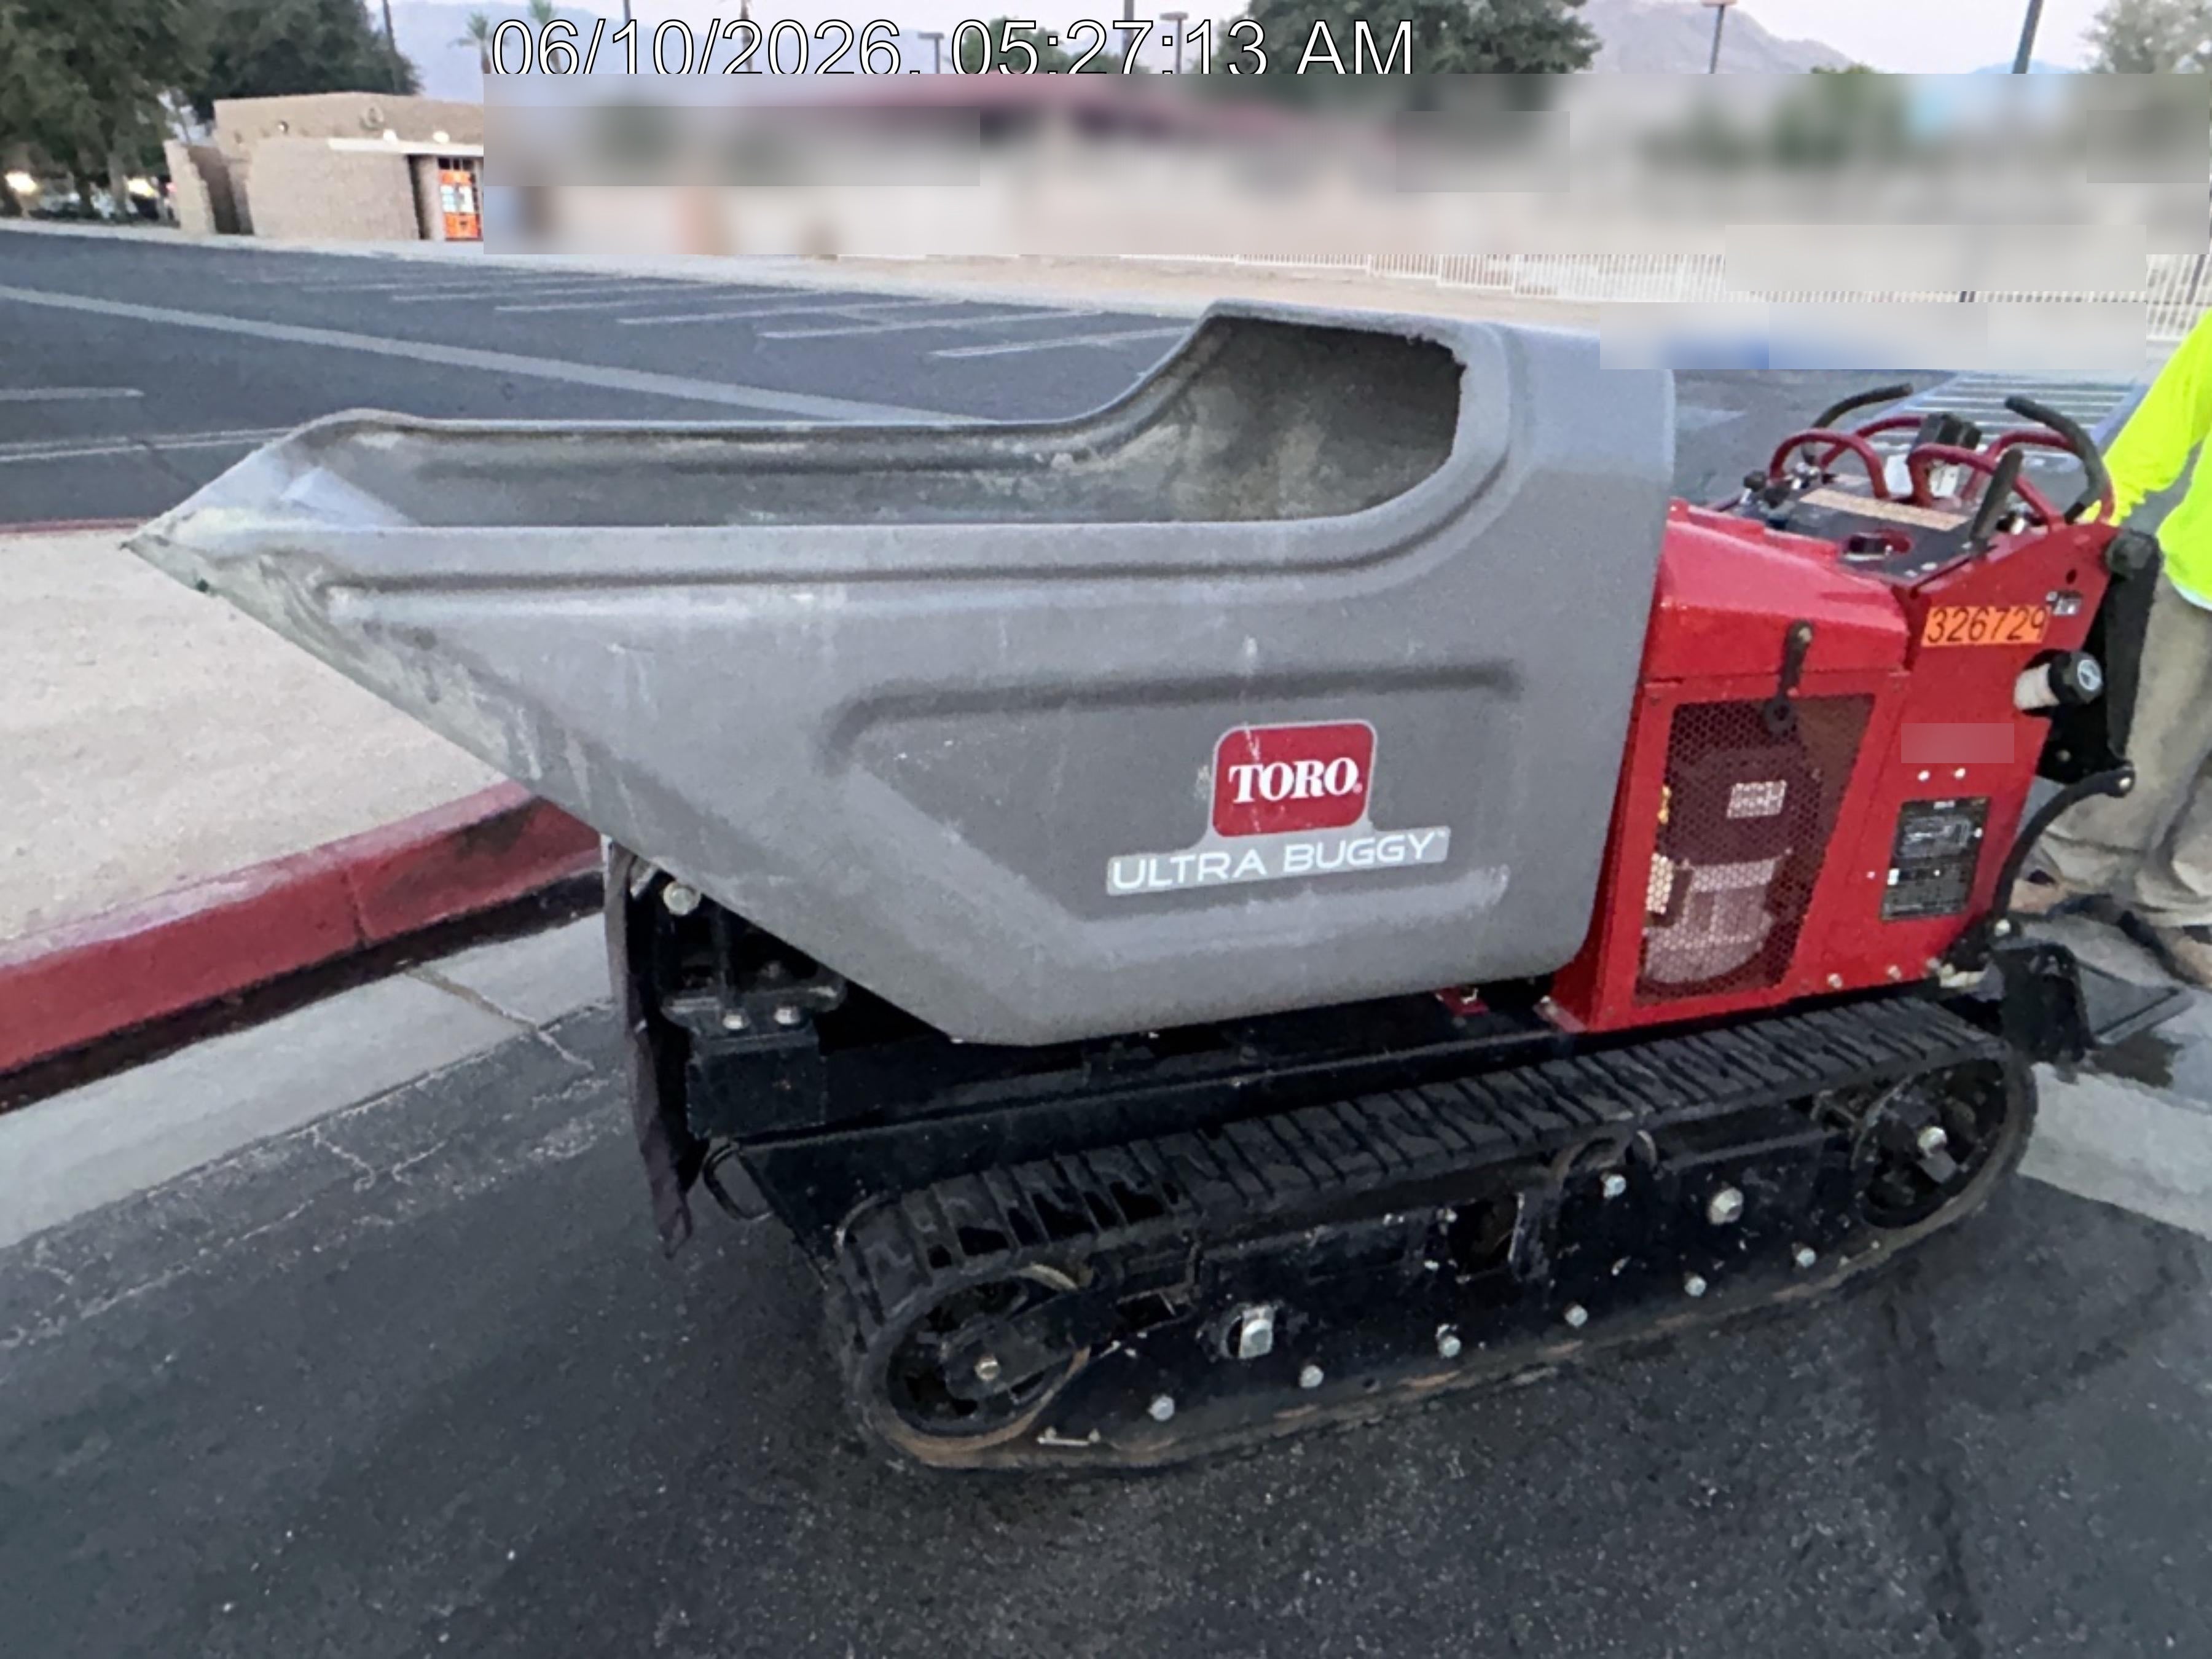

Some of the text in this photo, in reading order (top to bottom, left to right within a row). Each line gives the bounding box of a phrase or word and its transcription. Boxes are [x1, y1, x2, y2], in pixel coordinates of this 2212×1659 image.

[1927, 606, 2045, 643] 326729
[1229, 756, 1359, 804] TORO
[1112, 849, 1267, 890] ULTRA
